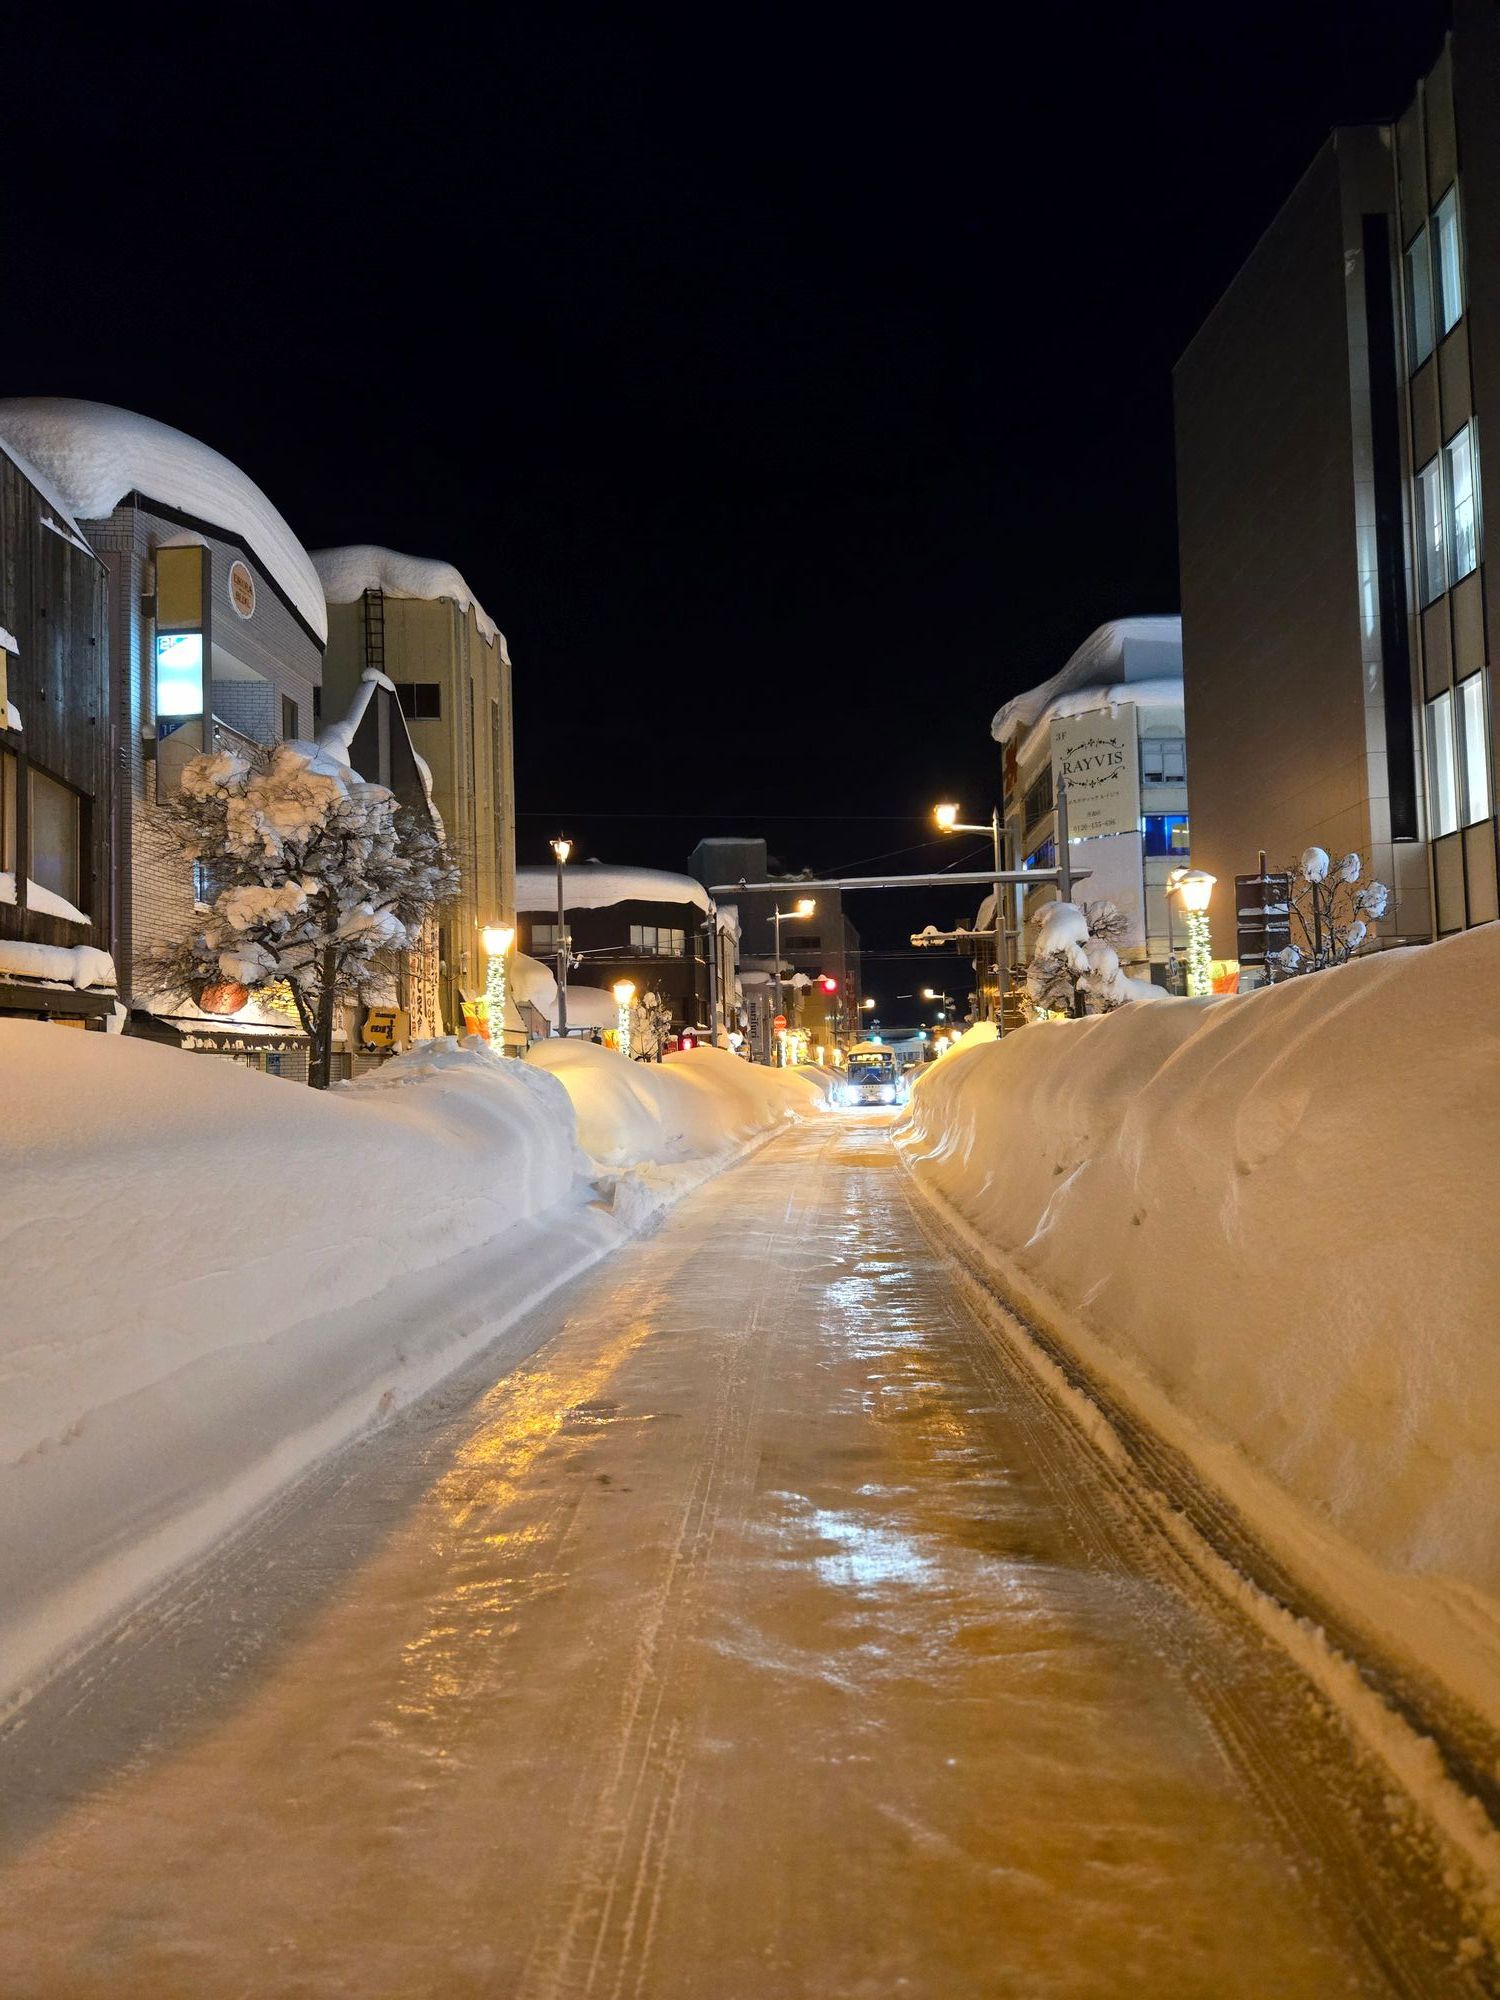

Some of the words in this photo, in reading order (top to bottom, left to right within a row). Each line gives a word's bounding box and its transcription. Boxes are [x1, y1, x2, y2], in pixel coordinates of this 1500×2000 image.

[161, 724, 176, 736] 1F
[1056, 731, 1067, 741] 3F
[1063, 751, 1123, 775] RAYVIS
